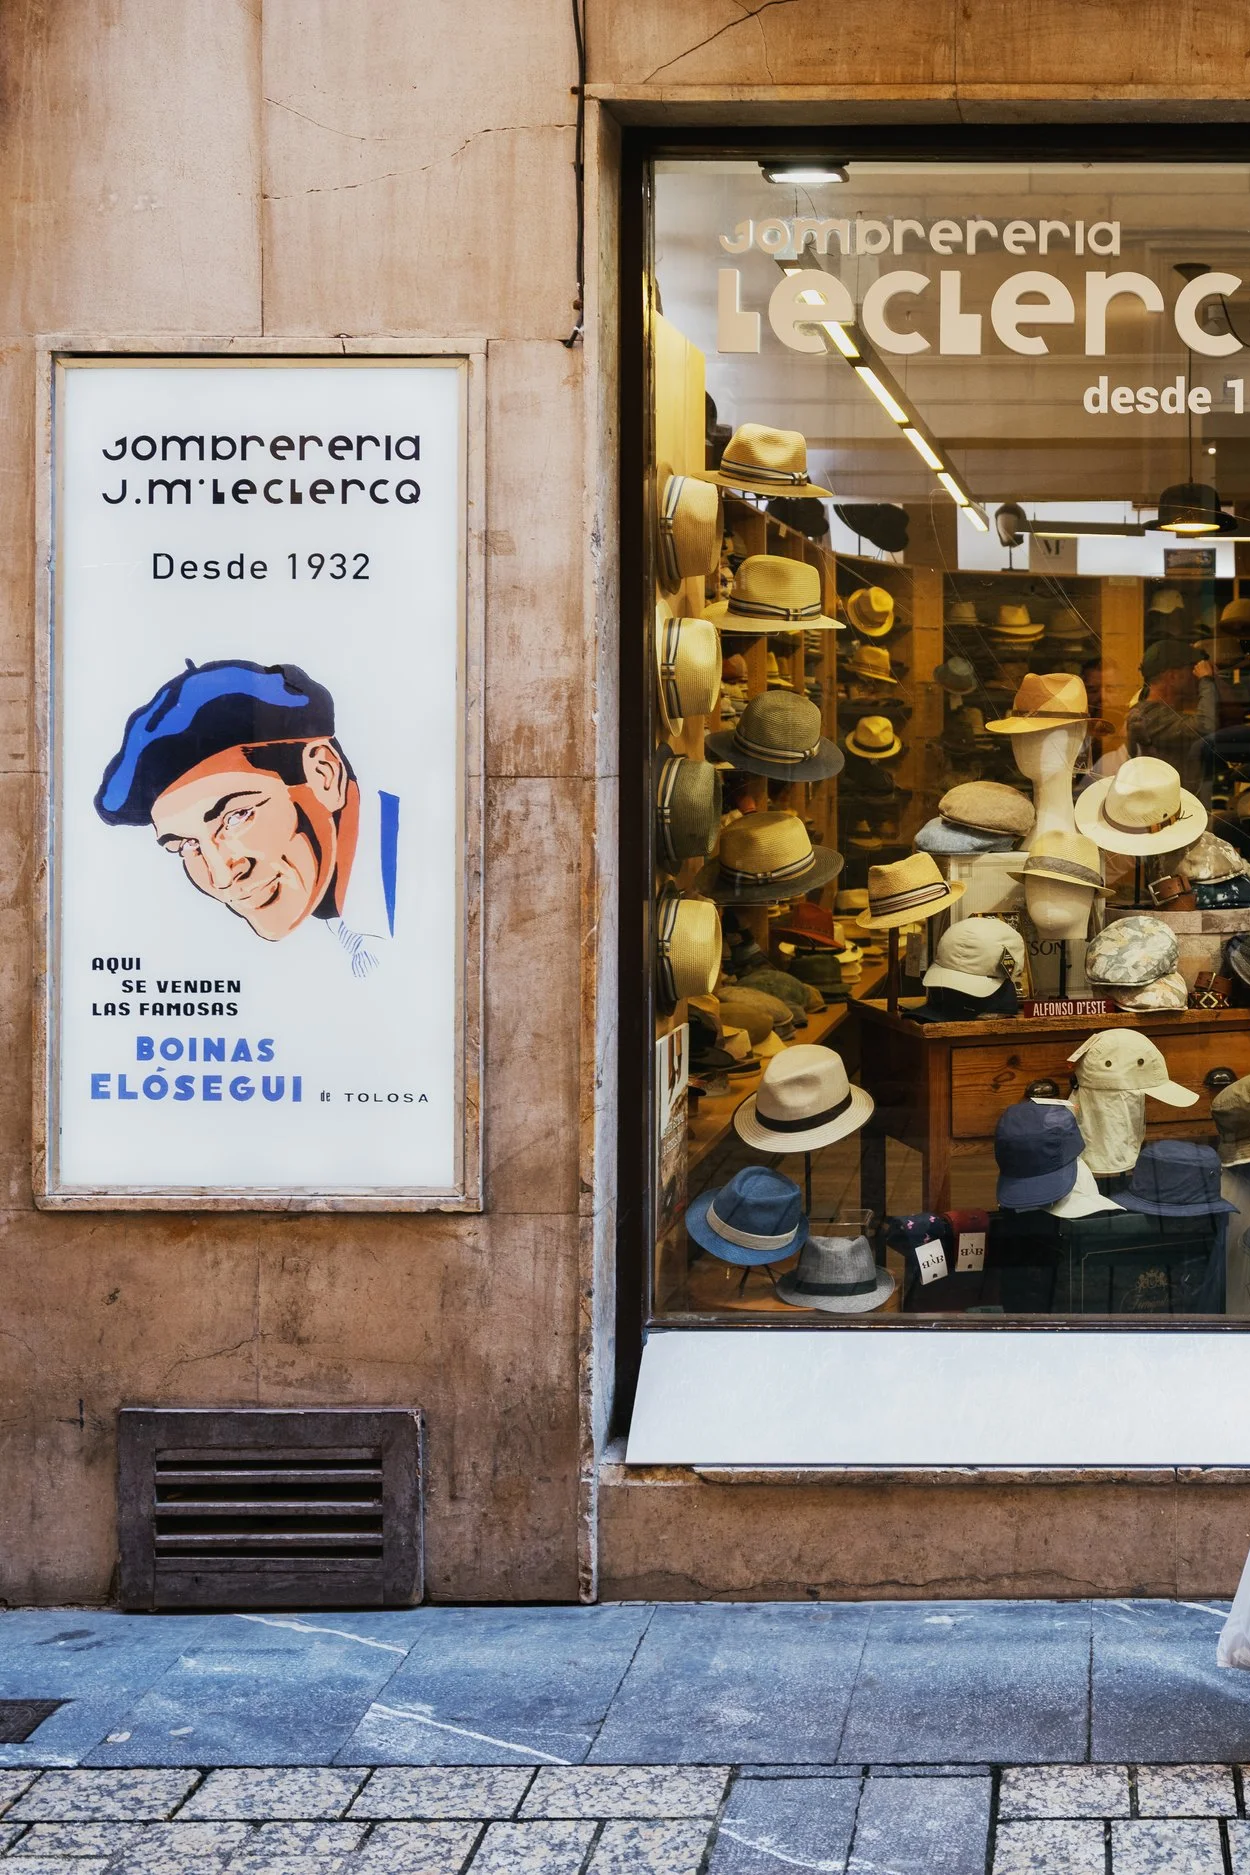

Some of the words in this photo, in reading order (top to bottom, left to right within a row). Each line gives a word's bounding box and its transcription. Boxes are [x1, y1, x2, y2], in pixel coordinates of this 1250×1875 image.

[1083, 375, 1211, 415] desde
[154, 553, 268, 580] Desde
[288, 553, 370, 580] 1932
[92, 957, 141, 974] AQUI
[121, 980, 147, 994] SE
[156, 980, 241, 994] VENDEN
[92, 1002, 131, 1016] LAS
[139, 1002, 239, 1017] FAMOSAS
[1033, 1002, 1073, 1016] ALFONSO
[136, 1035, 275, 1063] BOINAS
[344, 1092, 429, 1103] TOLOSA
